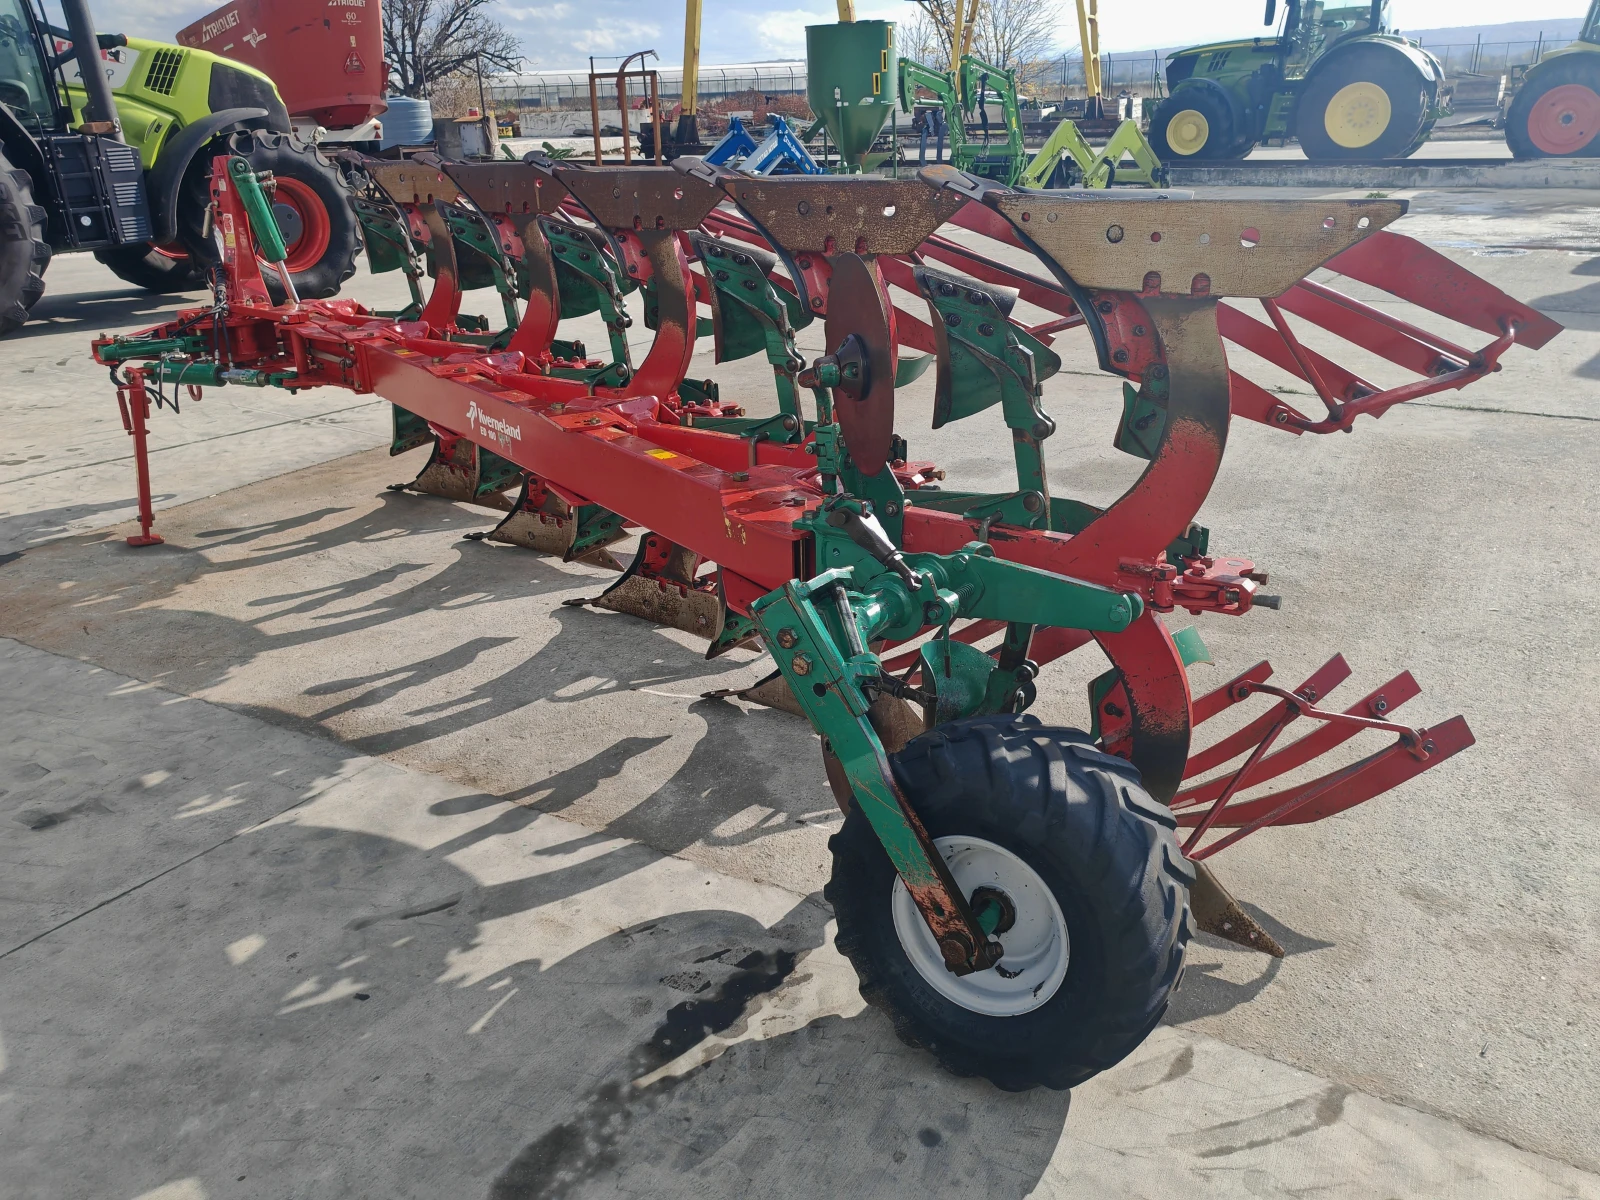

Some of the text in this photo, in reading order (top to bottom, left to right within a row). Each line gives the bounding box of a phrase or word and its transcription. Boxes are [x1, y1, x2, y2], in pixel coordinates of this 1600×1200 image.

[205, 10, 240, 40] TRIOLIET
[345, 12, 357, 20] 60
[478, 408, 522, 441] Kverneland
